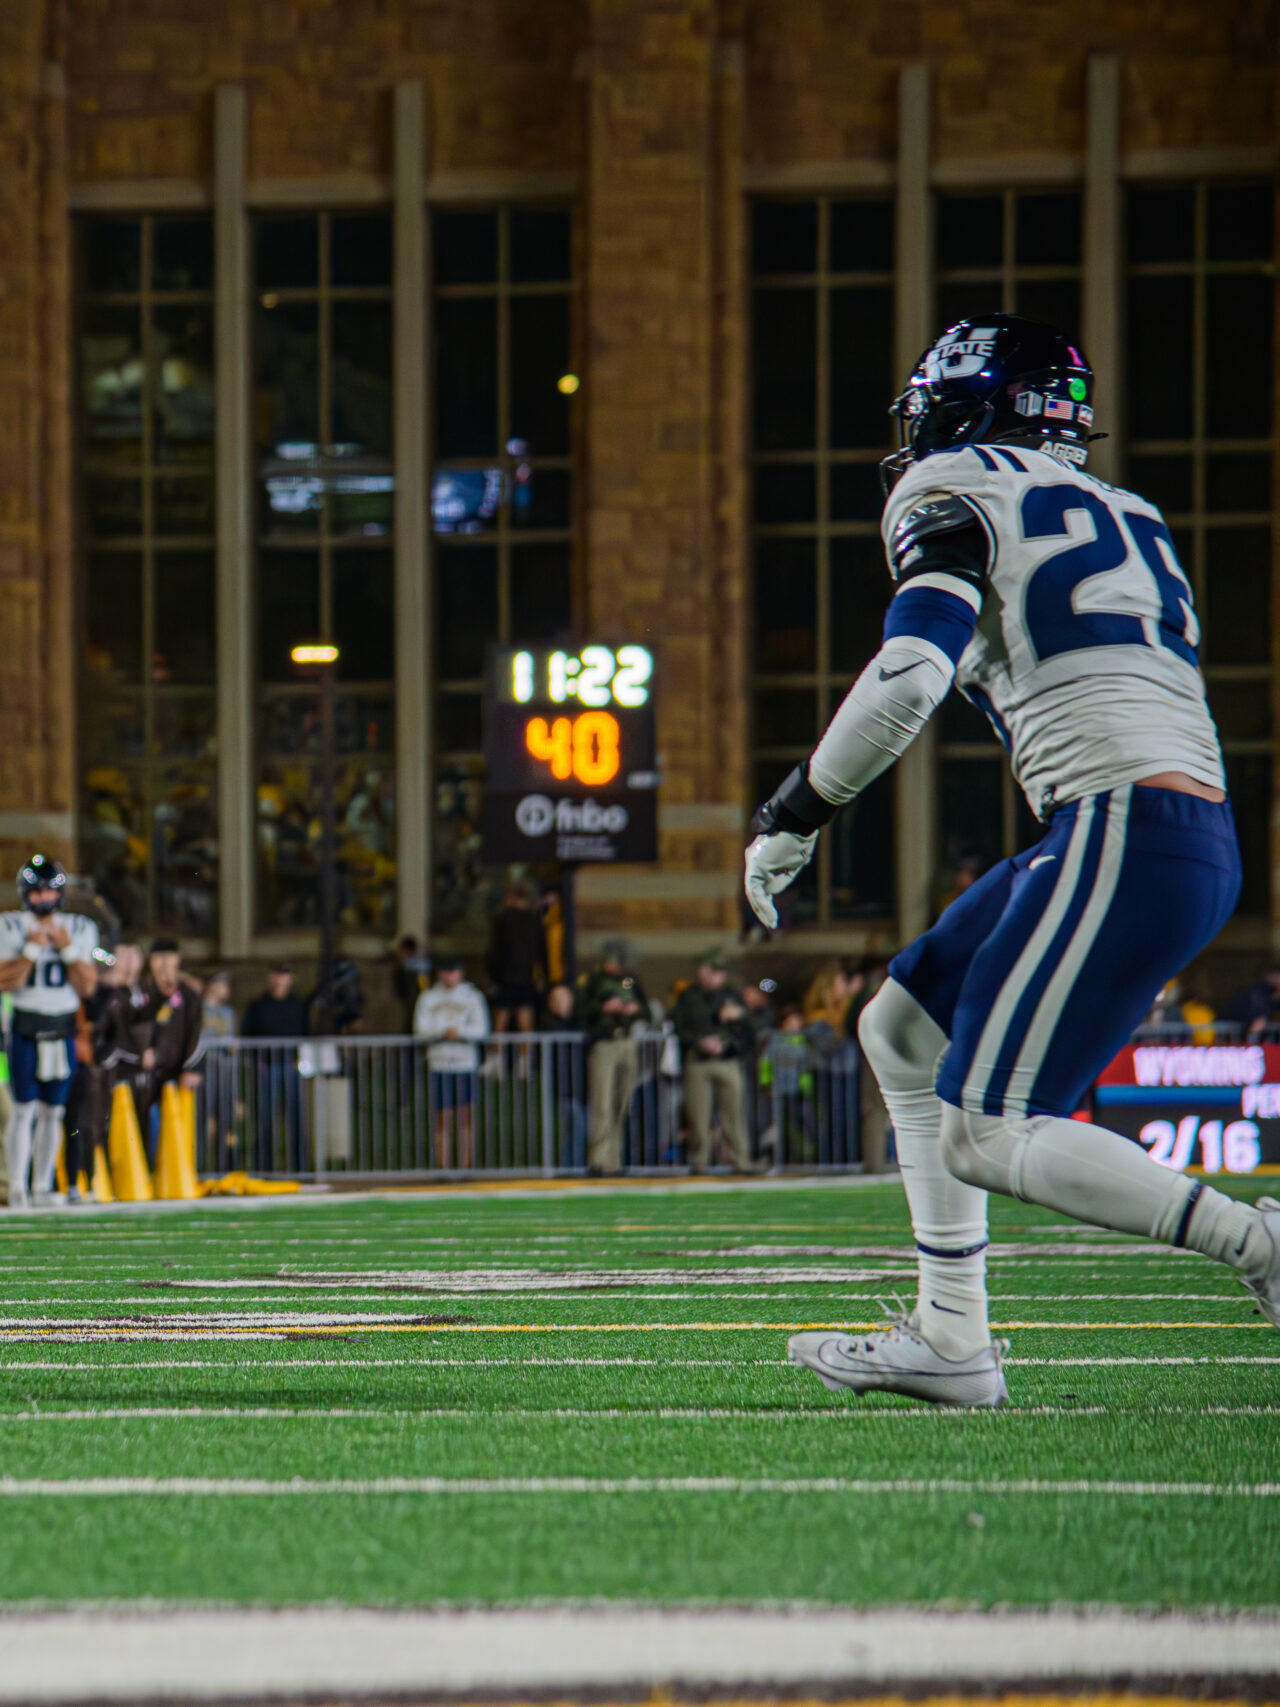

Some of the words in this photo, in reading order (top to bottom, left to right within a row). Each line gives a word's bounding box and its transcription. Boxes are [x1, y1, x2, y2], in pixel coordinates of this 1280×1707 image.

[512, 645, 653, 708] 11:22
[525, 710, 621, 786] 40
[1133, 1046, 1266, 1087] WYOMING
[1139, 1116, 1261, 1174] 2/16
